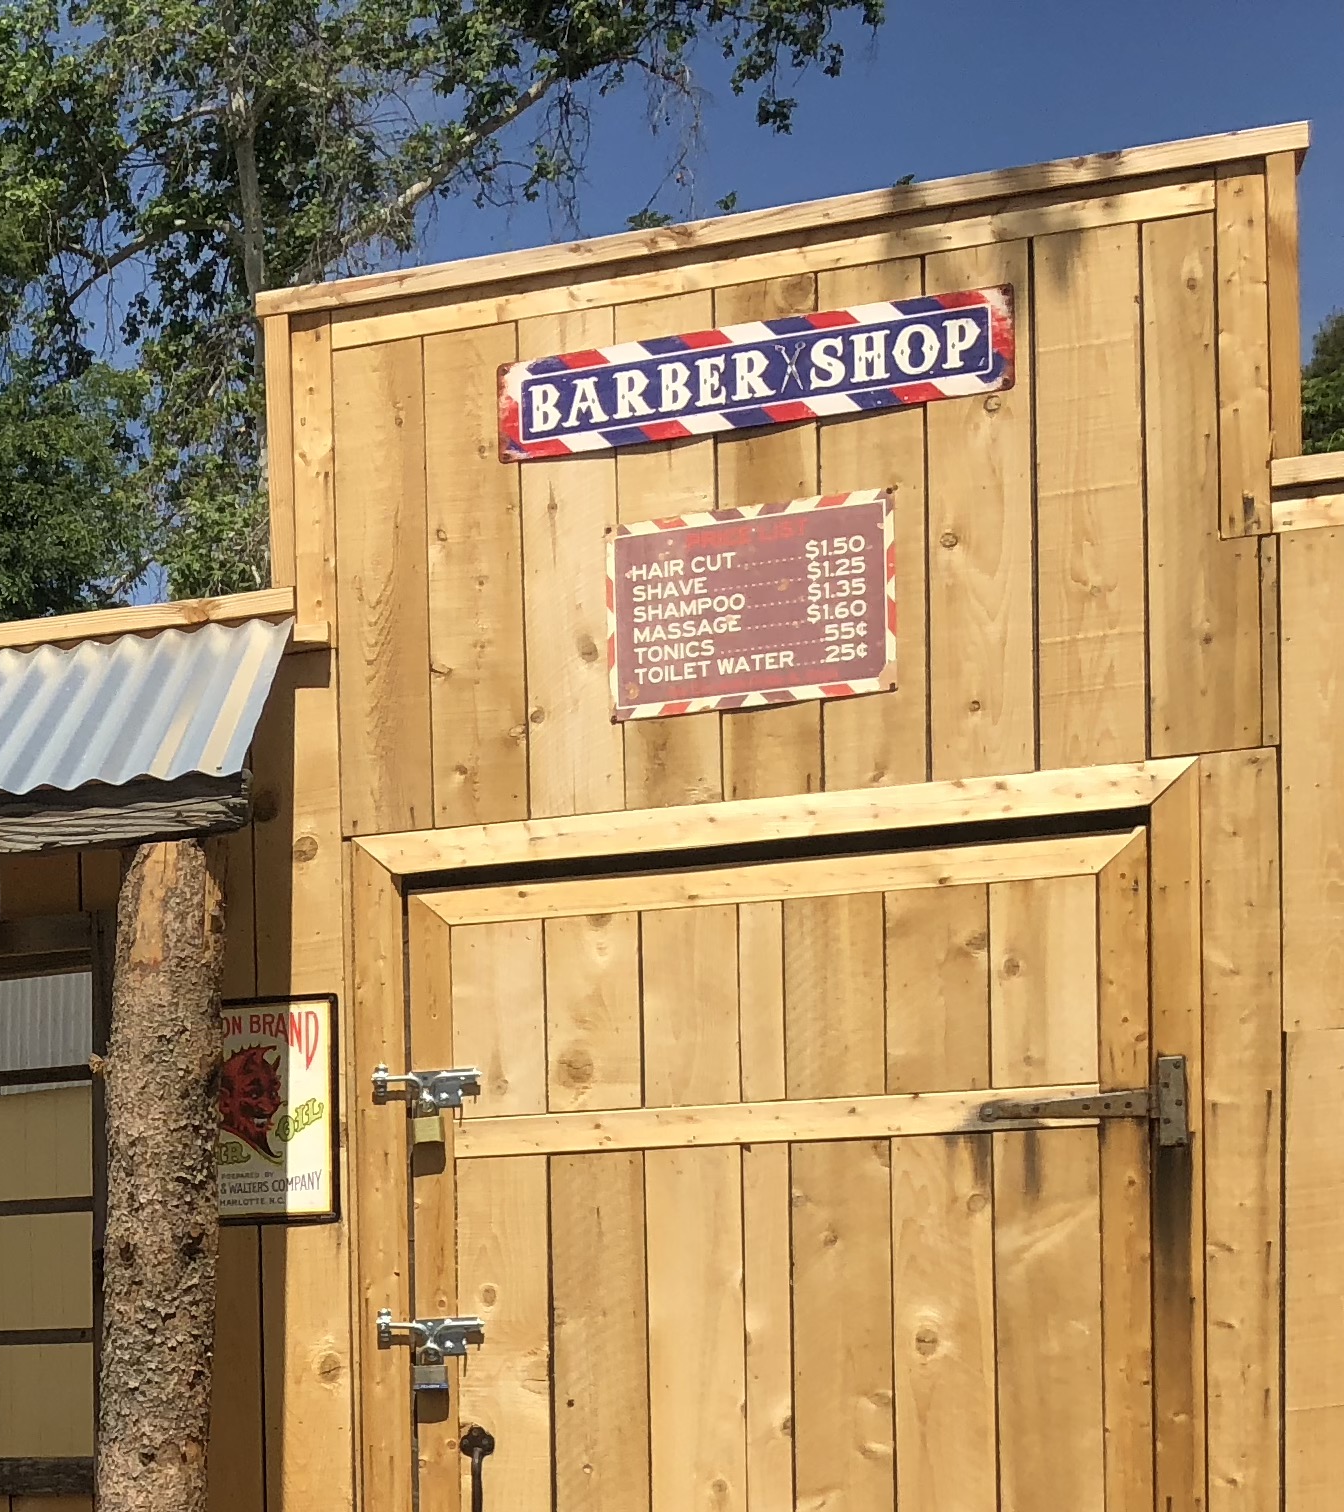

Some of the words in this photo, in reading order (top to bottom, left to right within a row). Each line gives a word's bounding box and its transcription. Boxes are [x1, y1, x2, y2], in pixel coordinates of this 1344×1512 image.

[528, 350, 777, 433] BARBER
[809, 317, 982, 390] SHOP
[685, 525, 750, 550] PRICE
[758, 516, 809, 543] LIST
[631, 558, 684, 582] HAIR
[691, 551, 737, 573] CUT
[805, 535, 866, 560] $1.50
[632, 577, 708, 603] SHAVE
[807, 556, 866, 582] $1.25
[633, 593, 746, 624] SHAMPOO
[807, 578, 867, 603] $1.35
[633, 614, 743, 644] MASSAGE
[806, 599, 867, 624] $1.60
[633, 639, 715, 666] TONICS
[634, 660, 711, 686] TOILET
[716, 650, 795, 676] WATER
[249, 1010, 320, 1071] BRAND
[274, 1097, 325, 1143] OIL
[221, 1172, 260, 1180] PREPARED
[228, 1181, 270, 1194] WALTERS
[271, 1168, 323, 1193] COMPANY
